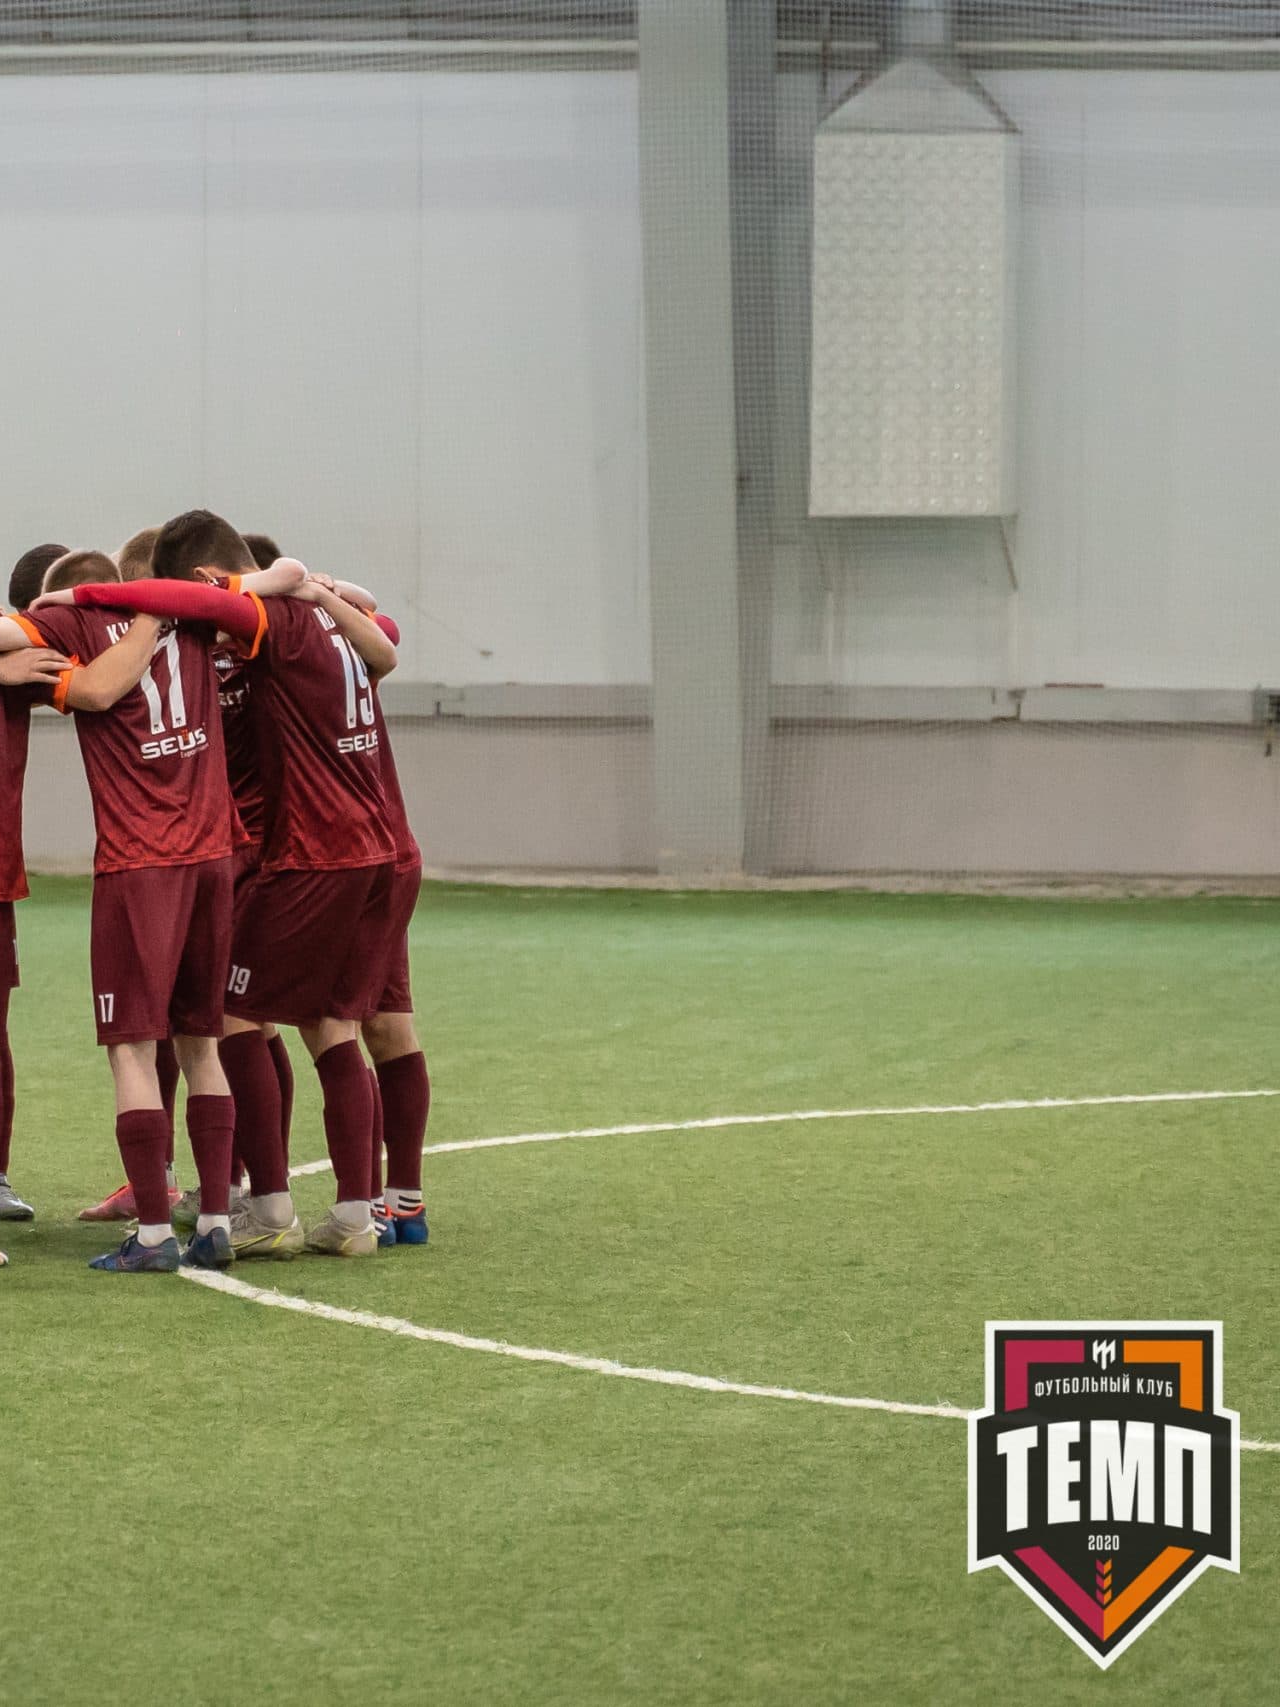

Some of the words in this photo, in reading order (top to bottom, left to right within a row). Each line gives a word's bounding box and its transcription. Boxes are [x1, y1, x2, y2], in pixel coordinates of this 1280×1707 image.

[140, 630, 186, 735] 17
[330, 634, 375, 729] 19
[140, 727, 207, 760] SEUS
[227, 965, 251, 995] 19
[98, 993, 114, 1024] 17
